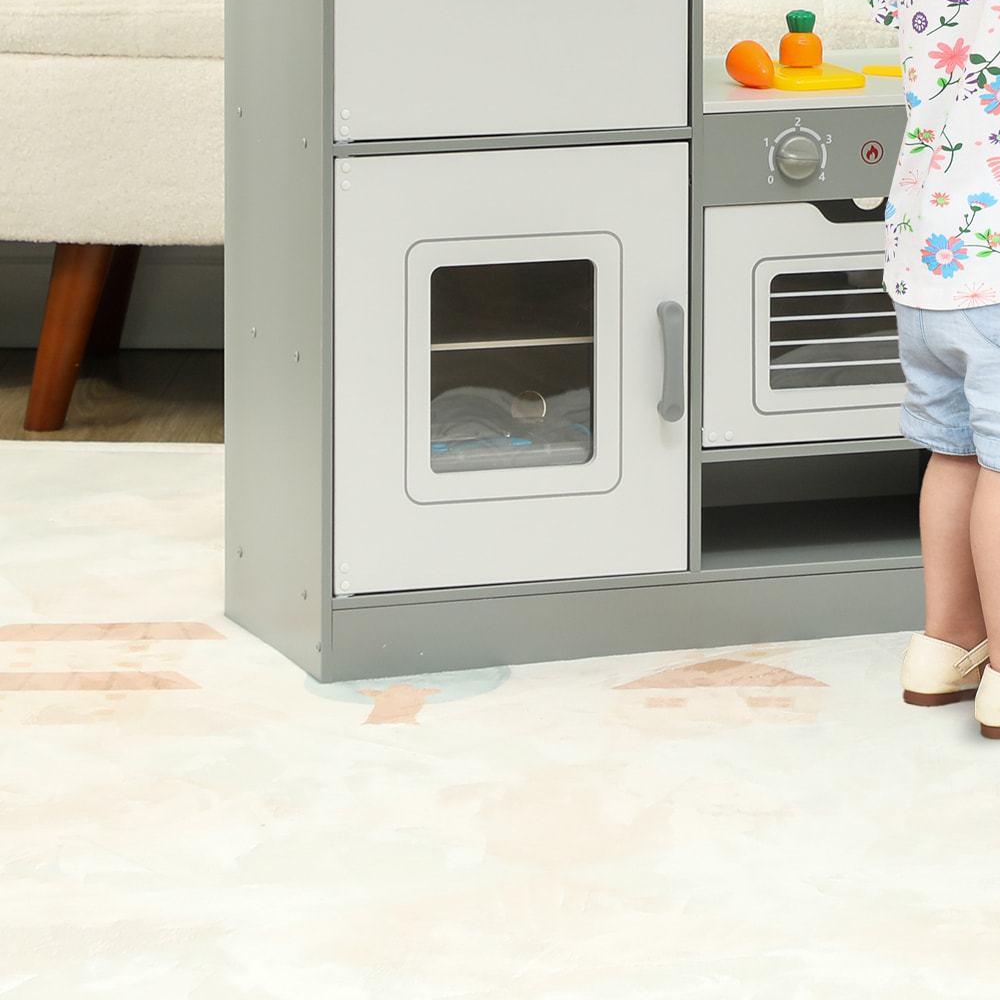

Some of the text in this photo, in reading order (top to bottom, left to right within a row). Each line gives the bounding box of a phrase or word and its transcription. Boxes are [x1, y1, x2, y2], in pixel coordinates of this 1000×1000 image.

[794, 117, 801, 127] 2
[763, 137, 769, 147] 1
[826, 134, 833, 144] 3
[767, 175, 774, 184] 0
[818, 172, 825, 181] 4
